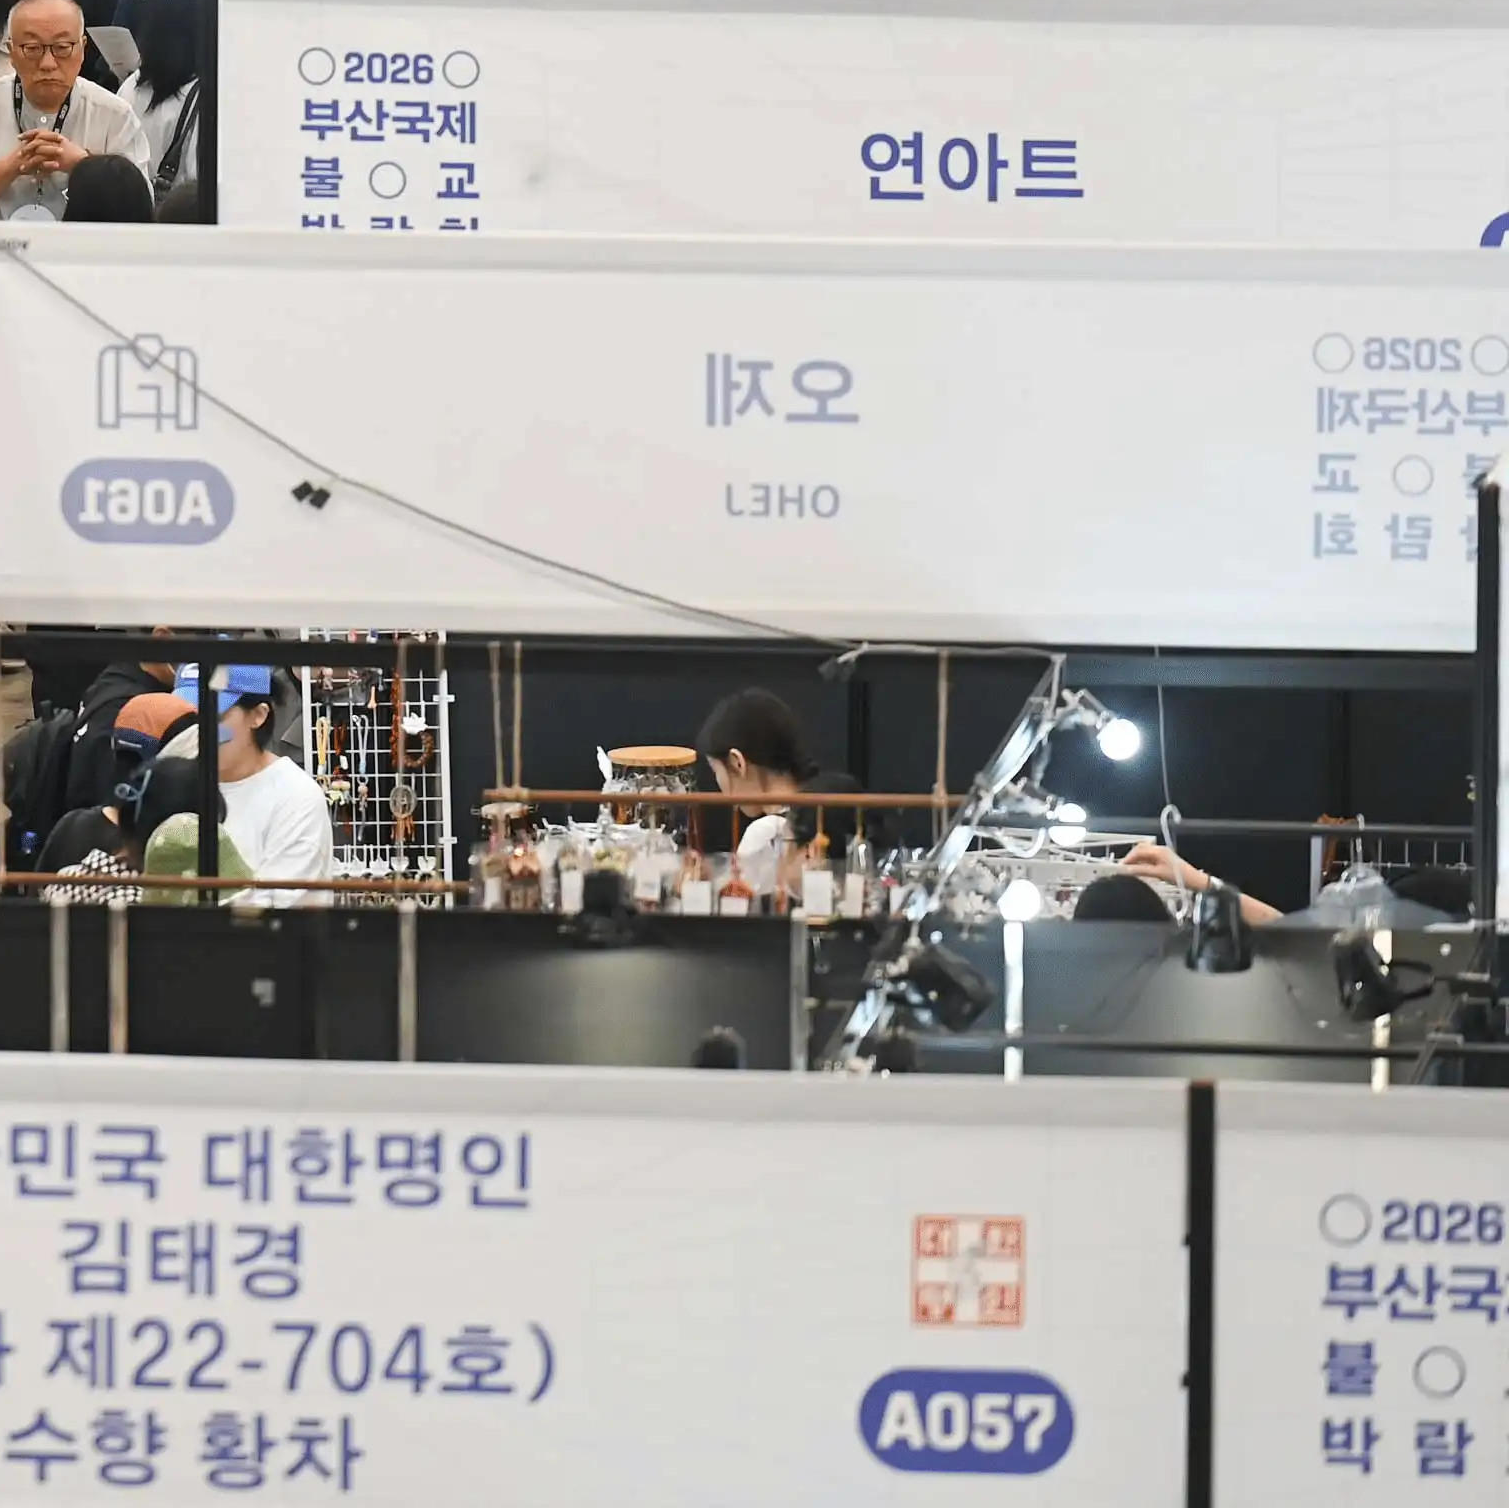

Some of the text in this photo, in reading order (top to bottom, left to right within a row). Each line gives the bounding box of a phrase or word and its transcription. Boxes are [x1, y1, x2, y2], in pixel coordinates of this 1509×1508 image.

[344, 51, 434, 85] 2026
[300, 98, 477, 145] 부산국제
[860, 131, 1085, 203] 연아트
[204, 1128, 530, 1210] 대한명인
[1382, 1201, 1504, 1245] 2026
[61, 1219, 301, 1301] 김태경
[1322, 1264, 1509, 1324] 부산국
[46, 1315, 555, 1403] 제22-704호)
[4, 1409, 362, 1492] 수향 황차
[877, 1391, 1056, 1452] A057
